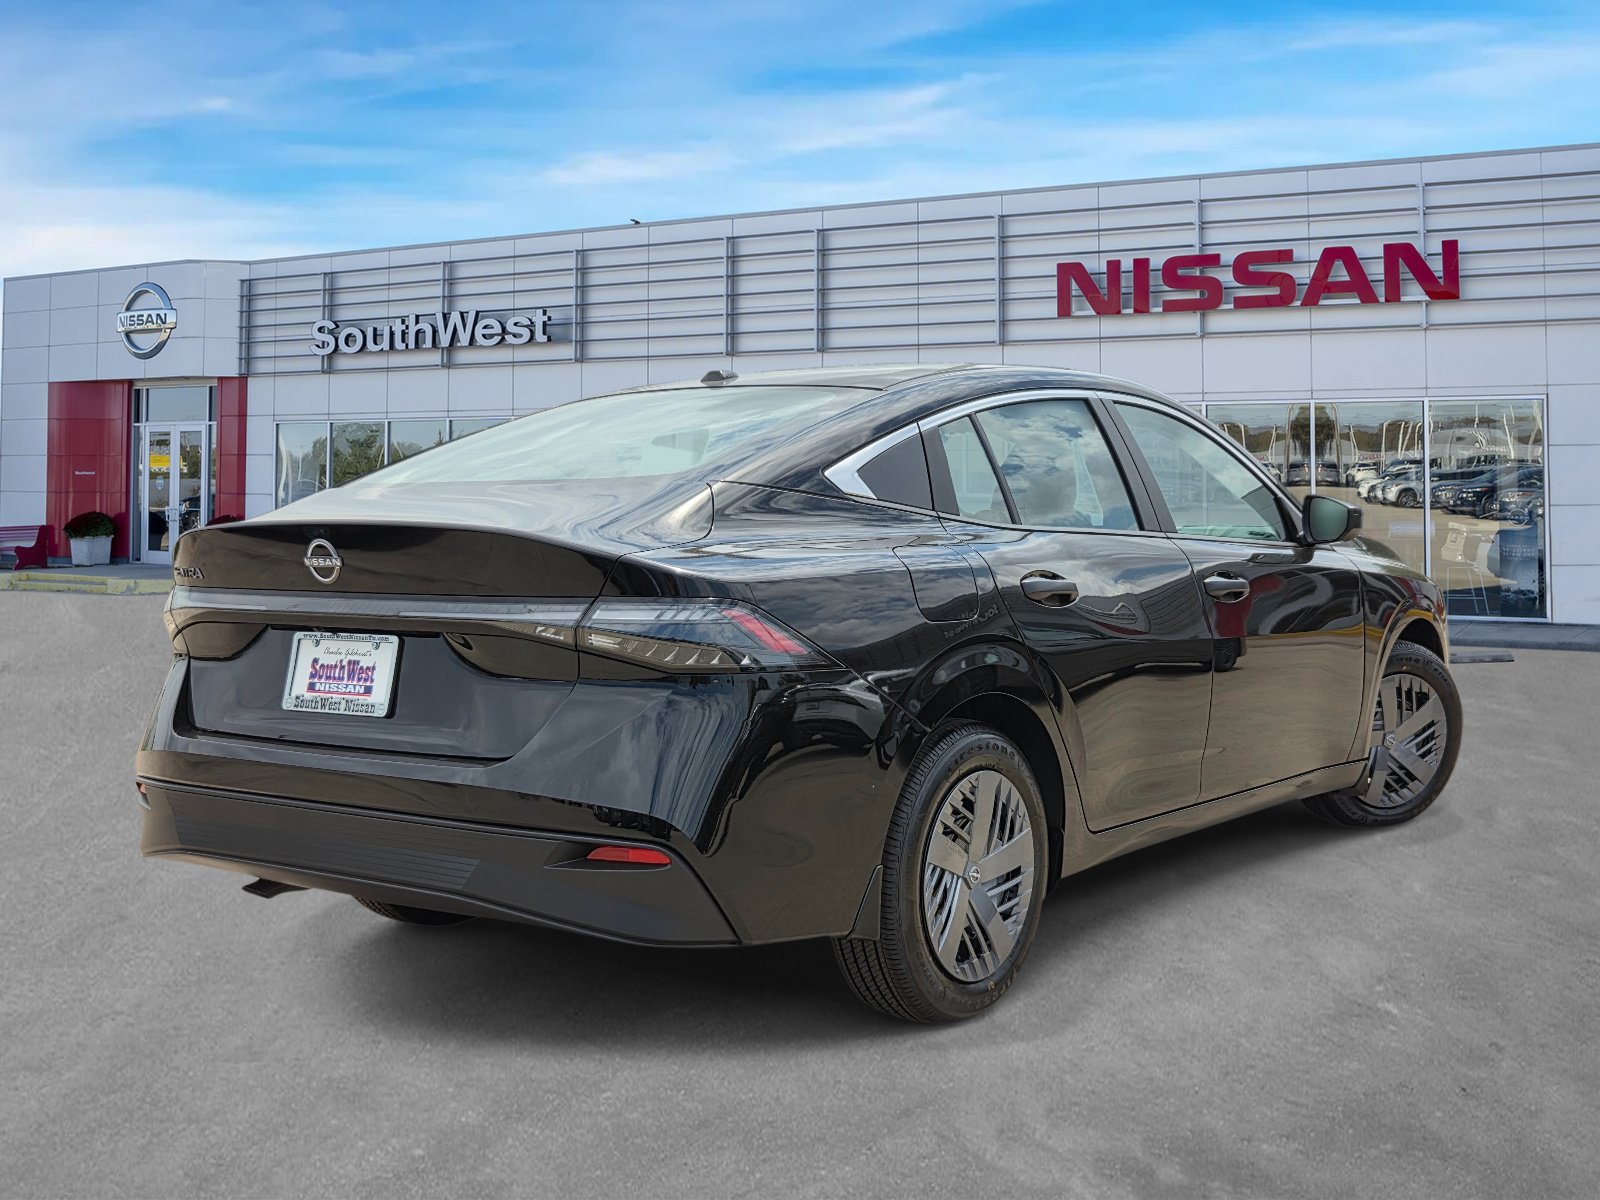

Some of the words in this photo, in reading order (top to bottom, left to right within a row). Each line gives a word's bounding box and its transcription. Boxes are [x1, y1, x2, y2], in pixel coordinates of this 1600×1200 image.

[1056, 239, 1460, 317] NISSAN
[118, 312, 168, 328] NISSAN
[309, 308, 551, 356] SouthWest
[304, 557, 341, 567] NISSAN
[315, 682, 365, 694] NISSAN
[343, 698, 376, 715] Nissan
